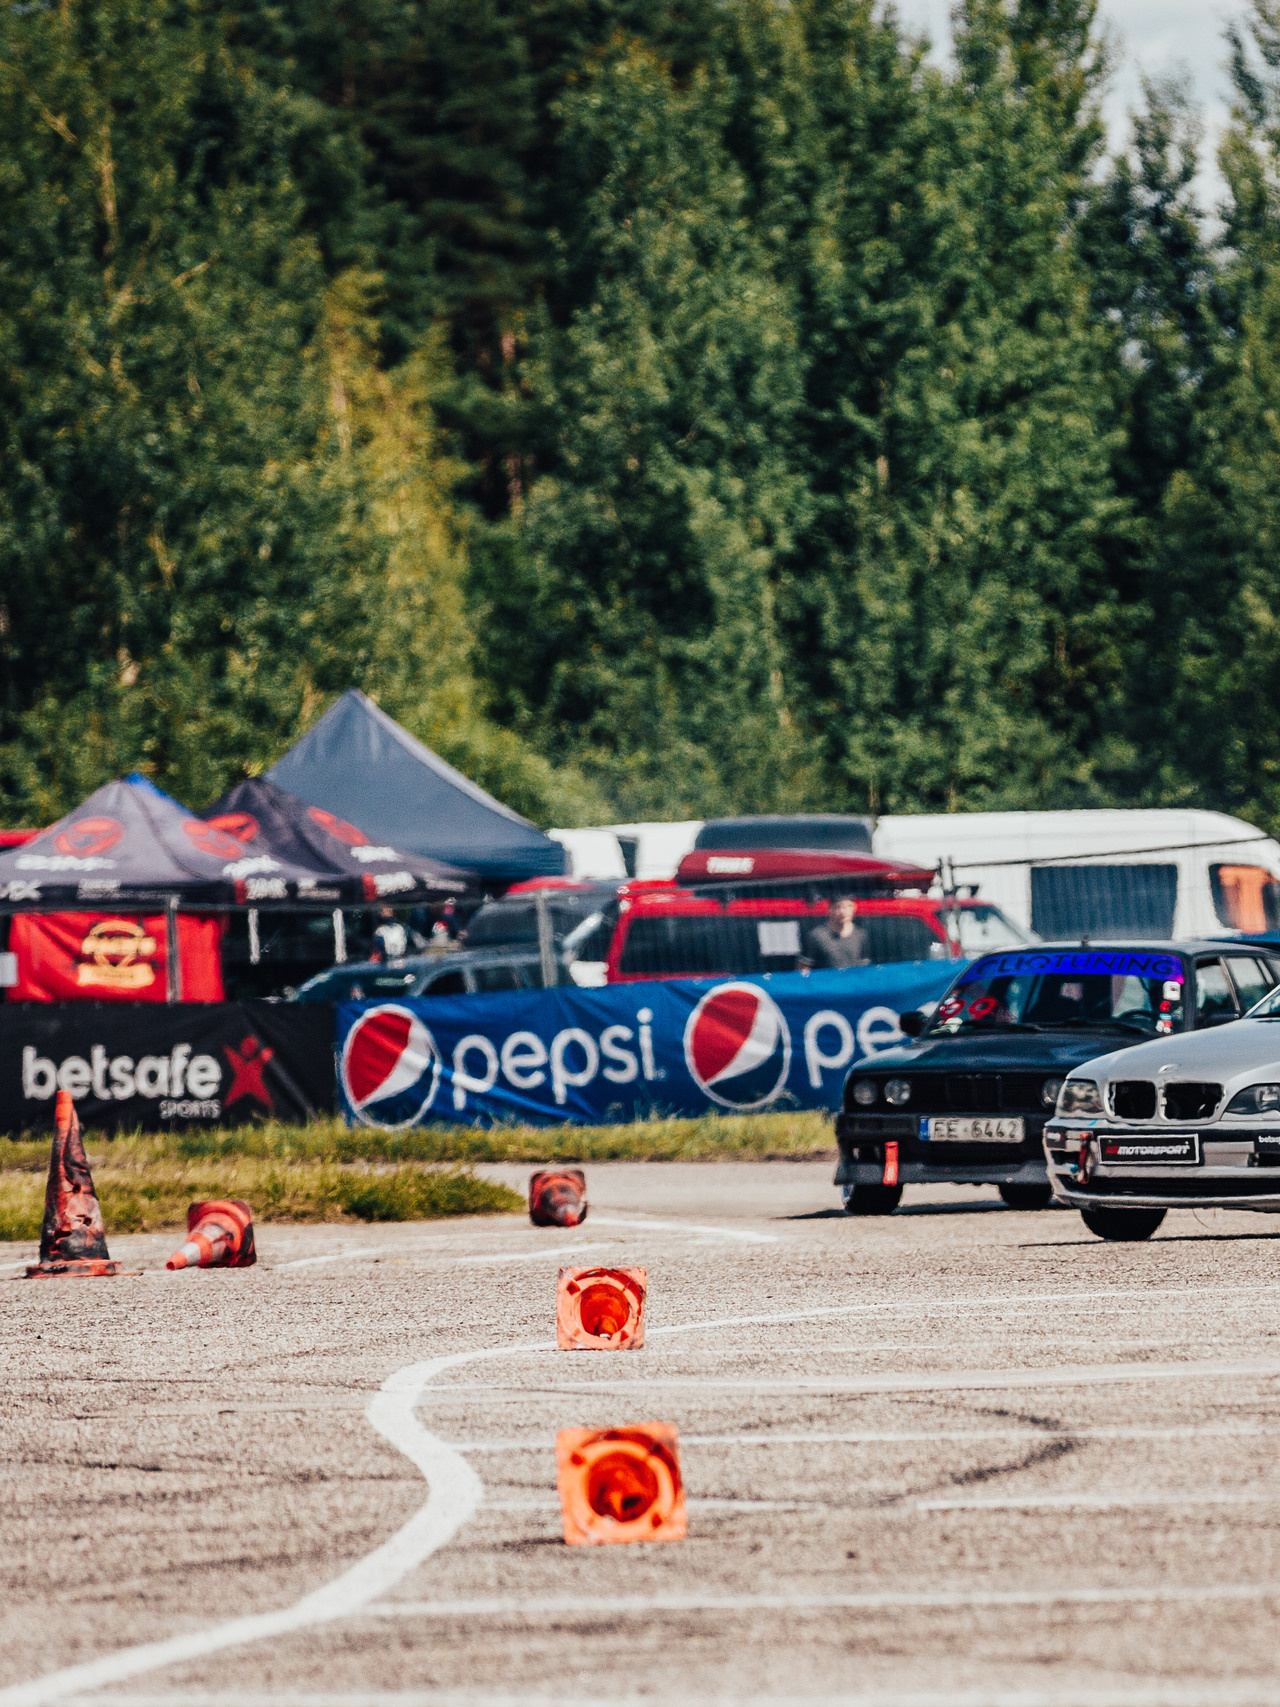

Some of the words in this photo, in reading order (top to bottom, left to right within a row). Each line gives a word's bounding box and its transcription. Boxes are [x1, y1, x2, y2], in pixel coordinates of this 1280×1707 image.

[977, 953, 1174, 975] CLIQTUNING
[22, 1043, 222, 1100] betsafe
[452, 1007, 656, 1111] pepsi
